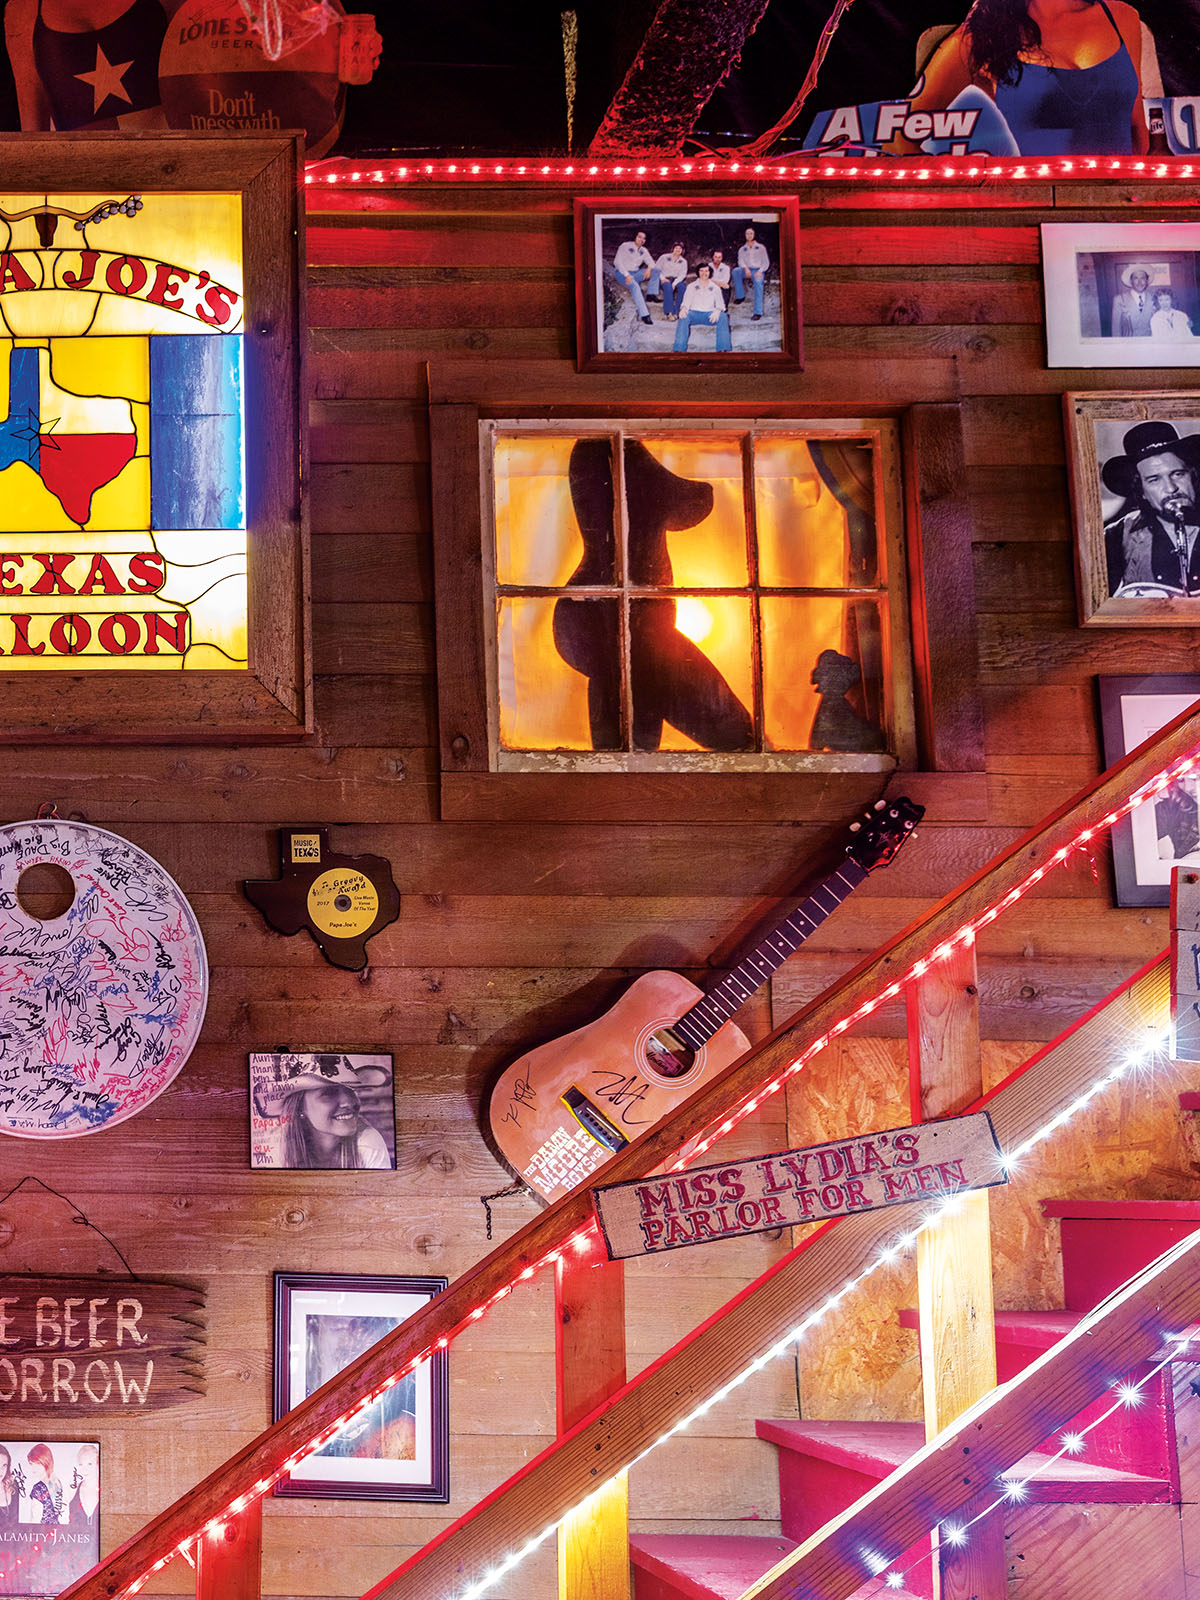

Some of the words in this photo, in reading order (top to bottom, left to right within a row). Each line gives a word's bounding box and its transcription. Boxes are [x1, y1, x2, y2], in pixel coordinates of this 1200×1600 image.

[211, 39, 254, 49] BEER
[207, 88, 257, 118] Don't
[238, 109, 281, 130] with
[822, 106, 860, 142] A
[875, 104, 982, 142] Few
[62, 251, 238, 328] JOE'S
[333, 875, 364, 888] Groovy
[529, 1126, 572, 1170] DAMN
[635, 1167, 748, 1220] MISS
[761, 1132, 922, 1194] LYDIA'S
[641, 1199, 786, 1252] PARLOR
[792, 1180, 874, 1220] FOR
[884, 1158, 971, 1202] MEN
[35, 1296, 149, 1348] BEER
